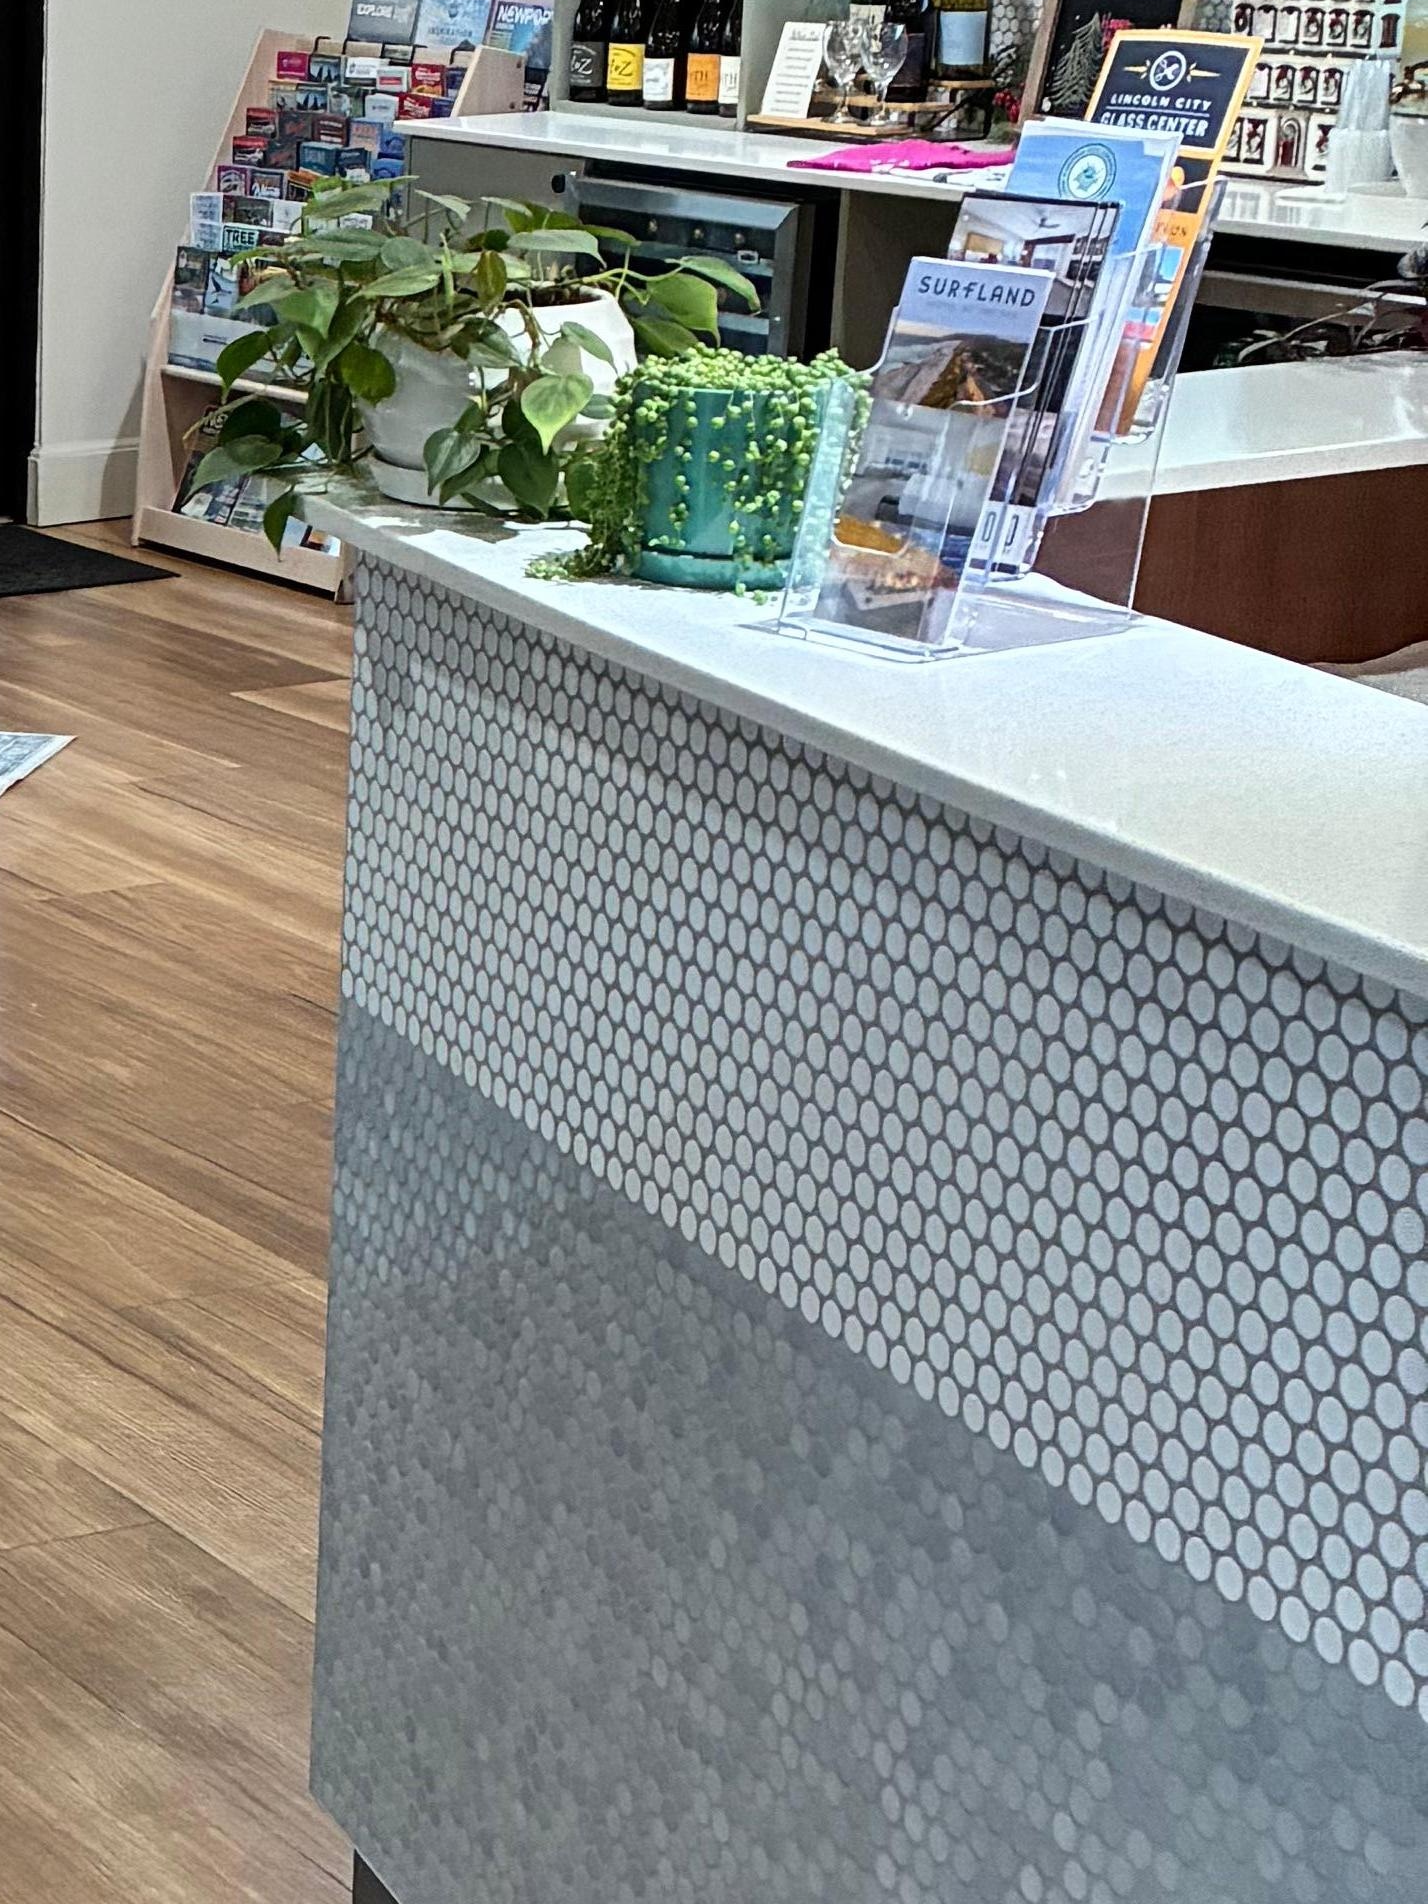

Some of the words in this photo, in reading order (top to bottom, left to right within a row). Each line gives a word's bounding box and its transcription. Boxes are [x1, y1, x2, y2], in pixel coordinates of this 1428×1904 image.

[497, 4, 554, 26] NEWPOR
[1110, 93, 1170, 108] LINCOLN
[1175, 97, 1212, 112] CITY
[1101, 111, 1145, 129] GLASS
[1146, 114, 1209, 137] CENTER
[225, 228, 256, 245] TREE
[918, 275, 1036, 308] SURFLAND
